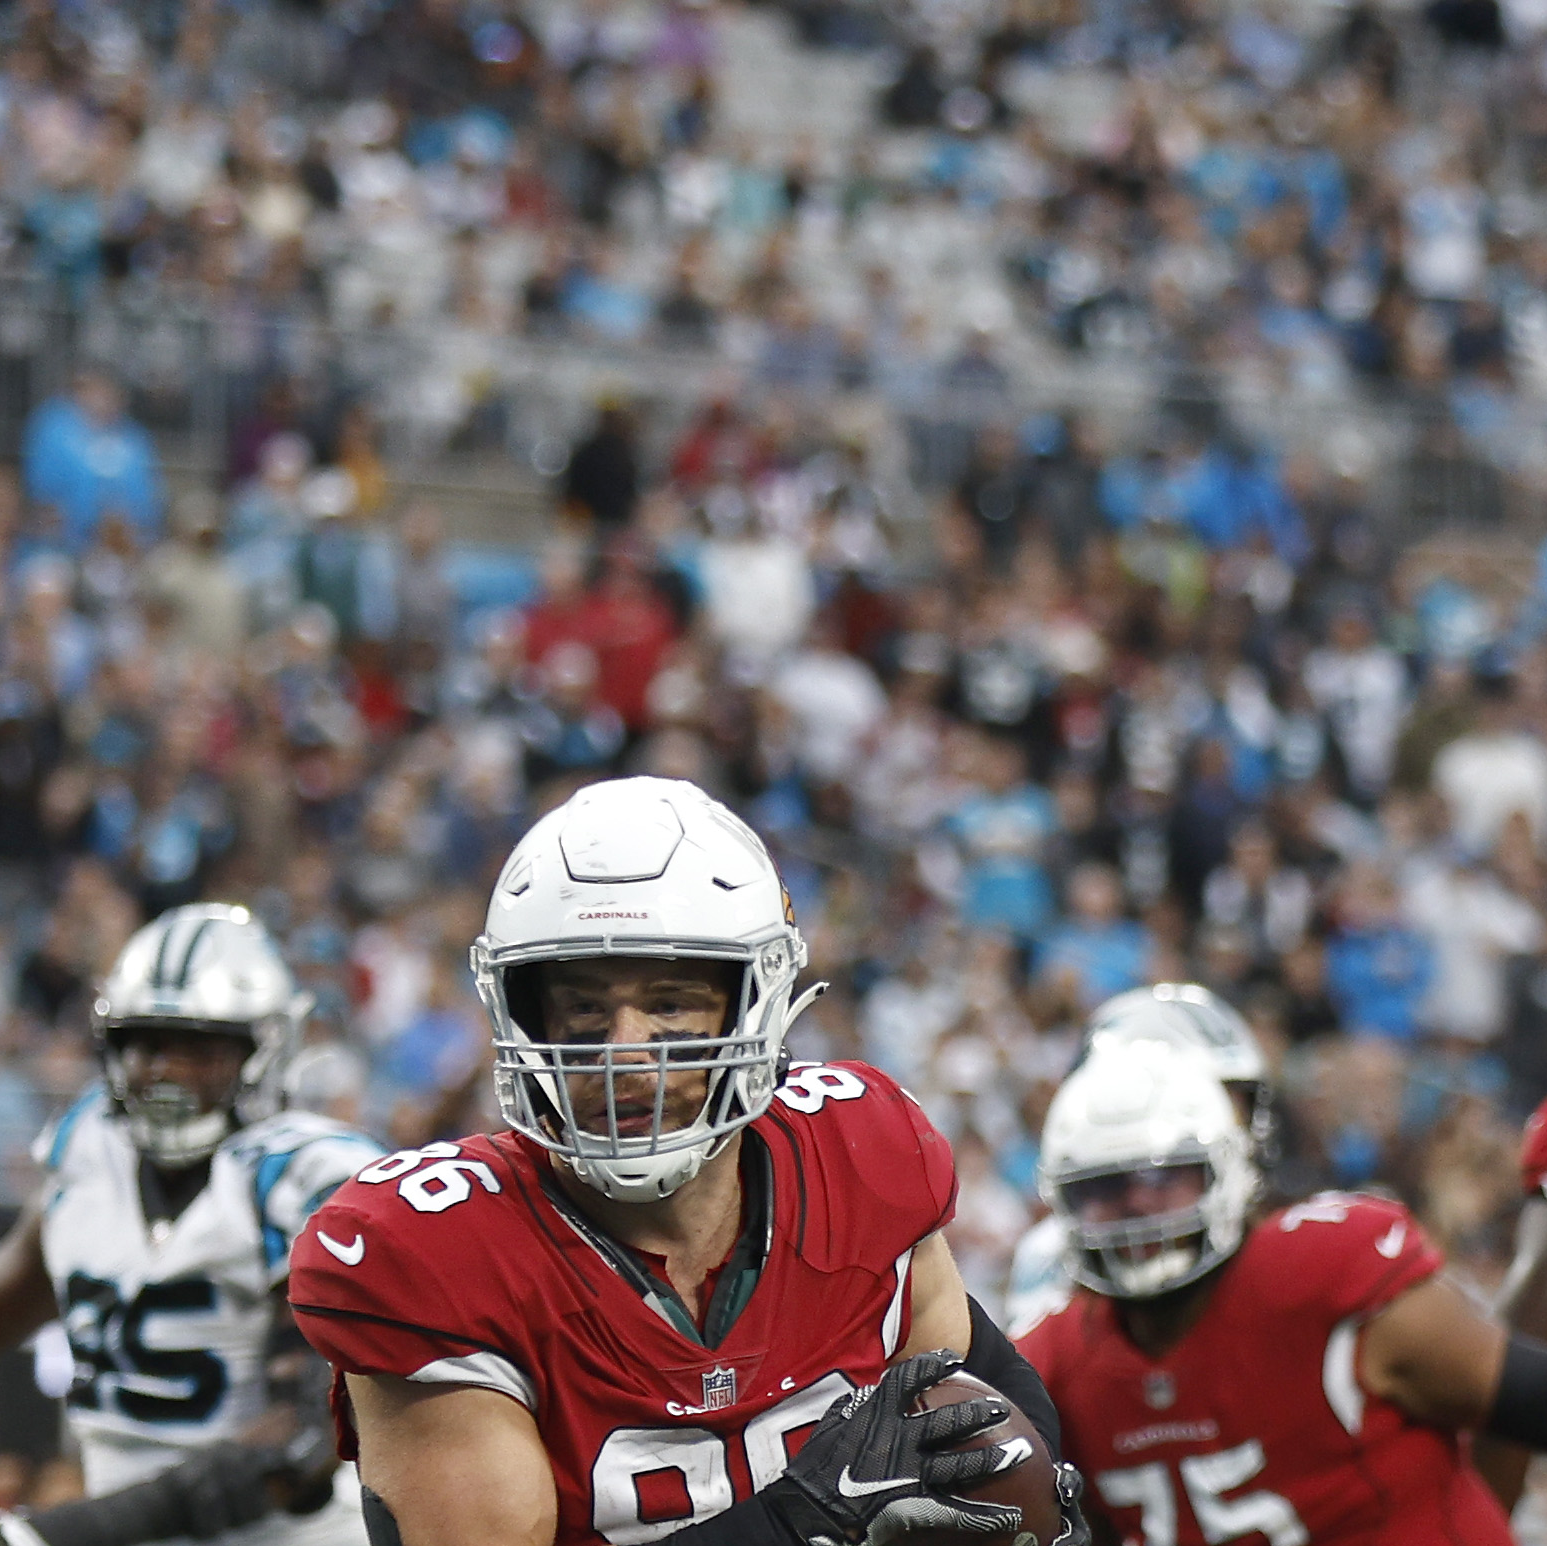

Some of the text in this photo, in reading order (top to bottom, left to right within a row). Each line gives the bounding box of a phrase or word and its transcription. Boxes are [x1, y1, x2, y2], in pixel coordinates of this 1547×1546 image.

[577, 911, 649, 921] CARDINALS
[356, 1141, 502, 1213] 86
[708, 1389, 732, 1408] NFL
